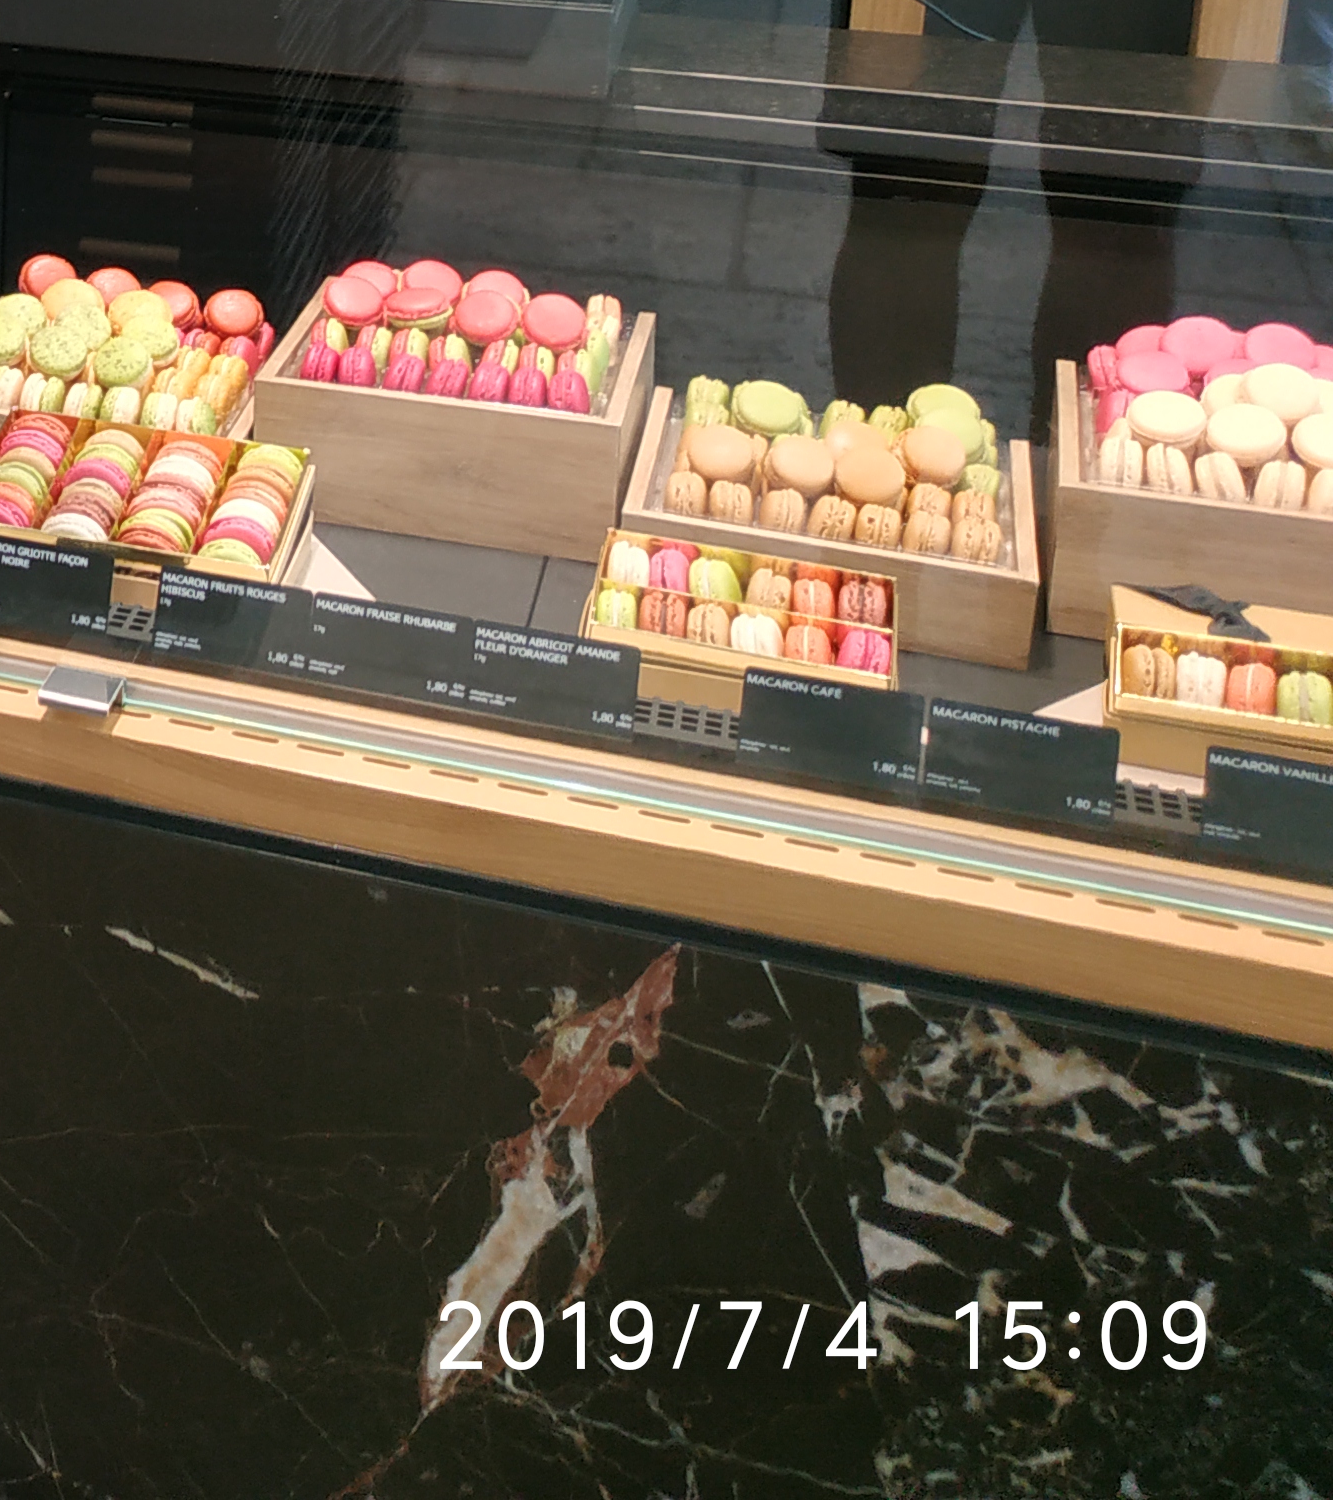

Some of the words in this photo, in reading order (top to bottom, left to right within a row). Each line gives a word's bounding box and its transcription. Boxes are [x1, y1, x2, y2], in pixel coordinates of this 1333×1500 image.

[1, 555, 31, 569] NOIRE
[17, 546, 56, 562] GRIOTTE
[57, 553, 89, 568] FAÇON
[161, 584, 206, 601] HIBISCUS
[162, 572, 209, 590] MACARON
[210, 581, 245, 596] FRUITS
[246, 586, 286, 603] ROUGES
[316, 598, 365, 617] MACARON
[366, 608, 402, 624] FRAISE
[403, 614, 457, 633] RHUBARBE
[475, 640, 507, 655] FLEUR
[509, 646, 569, 666] D'ORANGER
[476, 627, 528, 645] MACARON
[529, 636, 574, 653] ABRICOT
[576, 645, 621, 663] AMANDE
[267, 651, 288, 664] 1,80
[426, 680, 448, 693] 1,80
[747, 673, 809, 695] MACARON
[591, 710, 614, 724] 1,80
[933, 706, 998, 727] MACARON
[1000, 717, 1061, 738] PISTACHE
[872, 760, 897, 775] 1,80
[1210, 753, 1280, 775] MACARON
[1066, 796, 1092, 810] 1,80
